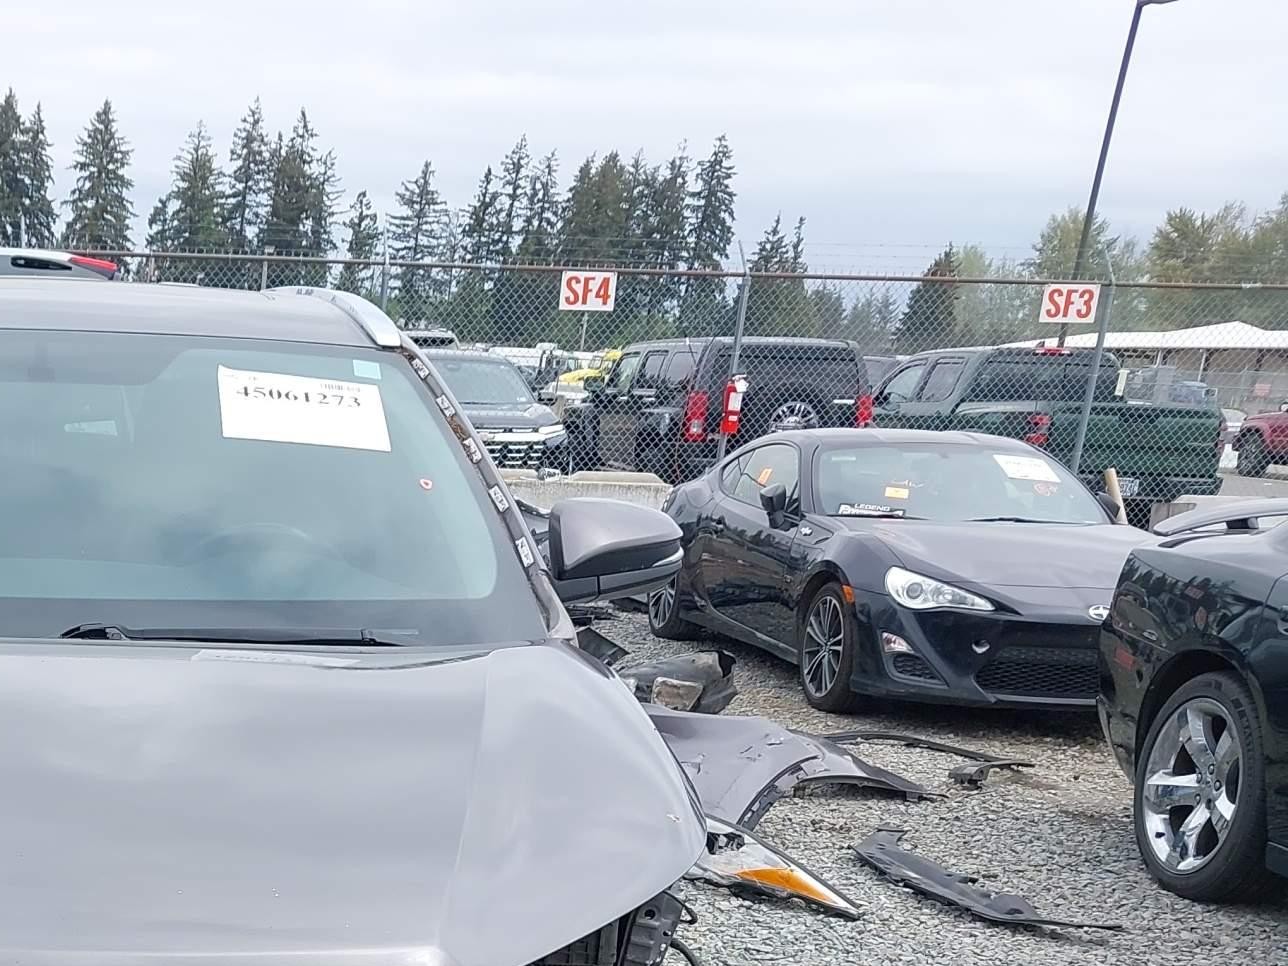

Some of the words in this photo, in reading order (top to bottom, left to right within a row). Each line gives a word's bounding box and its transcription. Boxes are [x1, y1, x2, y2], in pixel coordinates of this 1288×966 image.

[564, 275, 611, 306] SF4
[1045, 288, 1095, 319] SF3
[236, 385, 361, 408] 45061273
